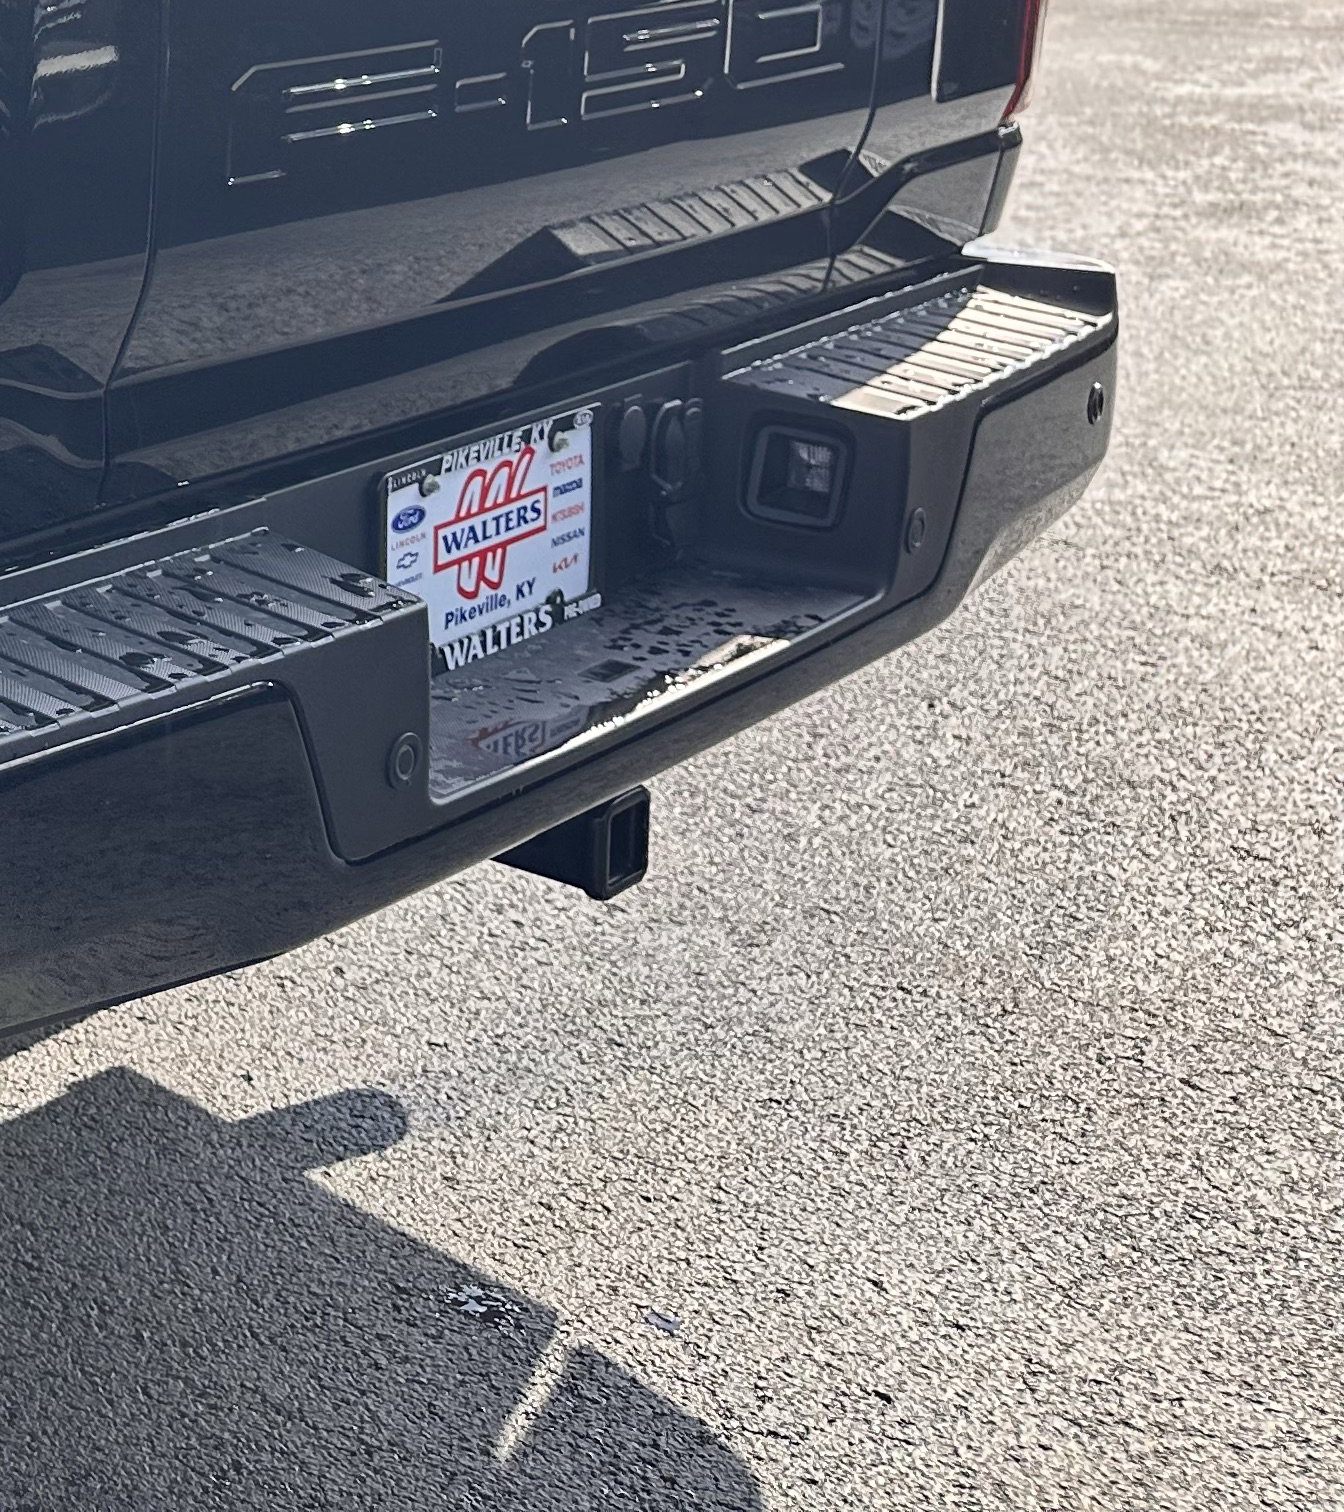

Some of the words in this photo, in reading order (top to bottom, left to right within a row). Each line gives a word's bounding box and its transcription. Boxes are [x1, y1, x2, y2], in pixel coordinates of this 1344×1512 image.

[531, 418, 554, 450] KY
[442, 498, 542, 555] WALTERS
[551, 527, 585, 548] NISSAN
[444, 592, 512, 630] Pikeville,
[515, 577, 537, 601] KY
[442, 603, 553, 671] WALTERS
